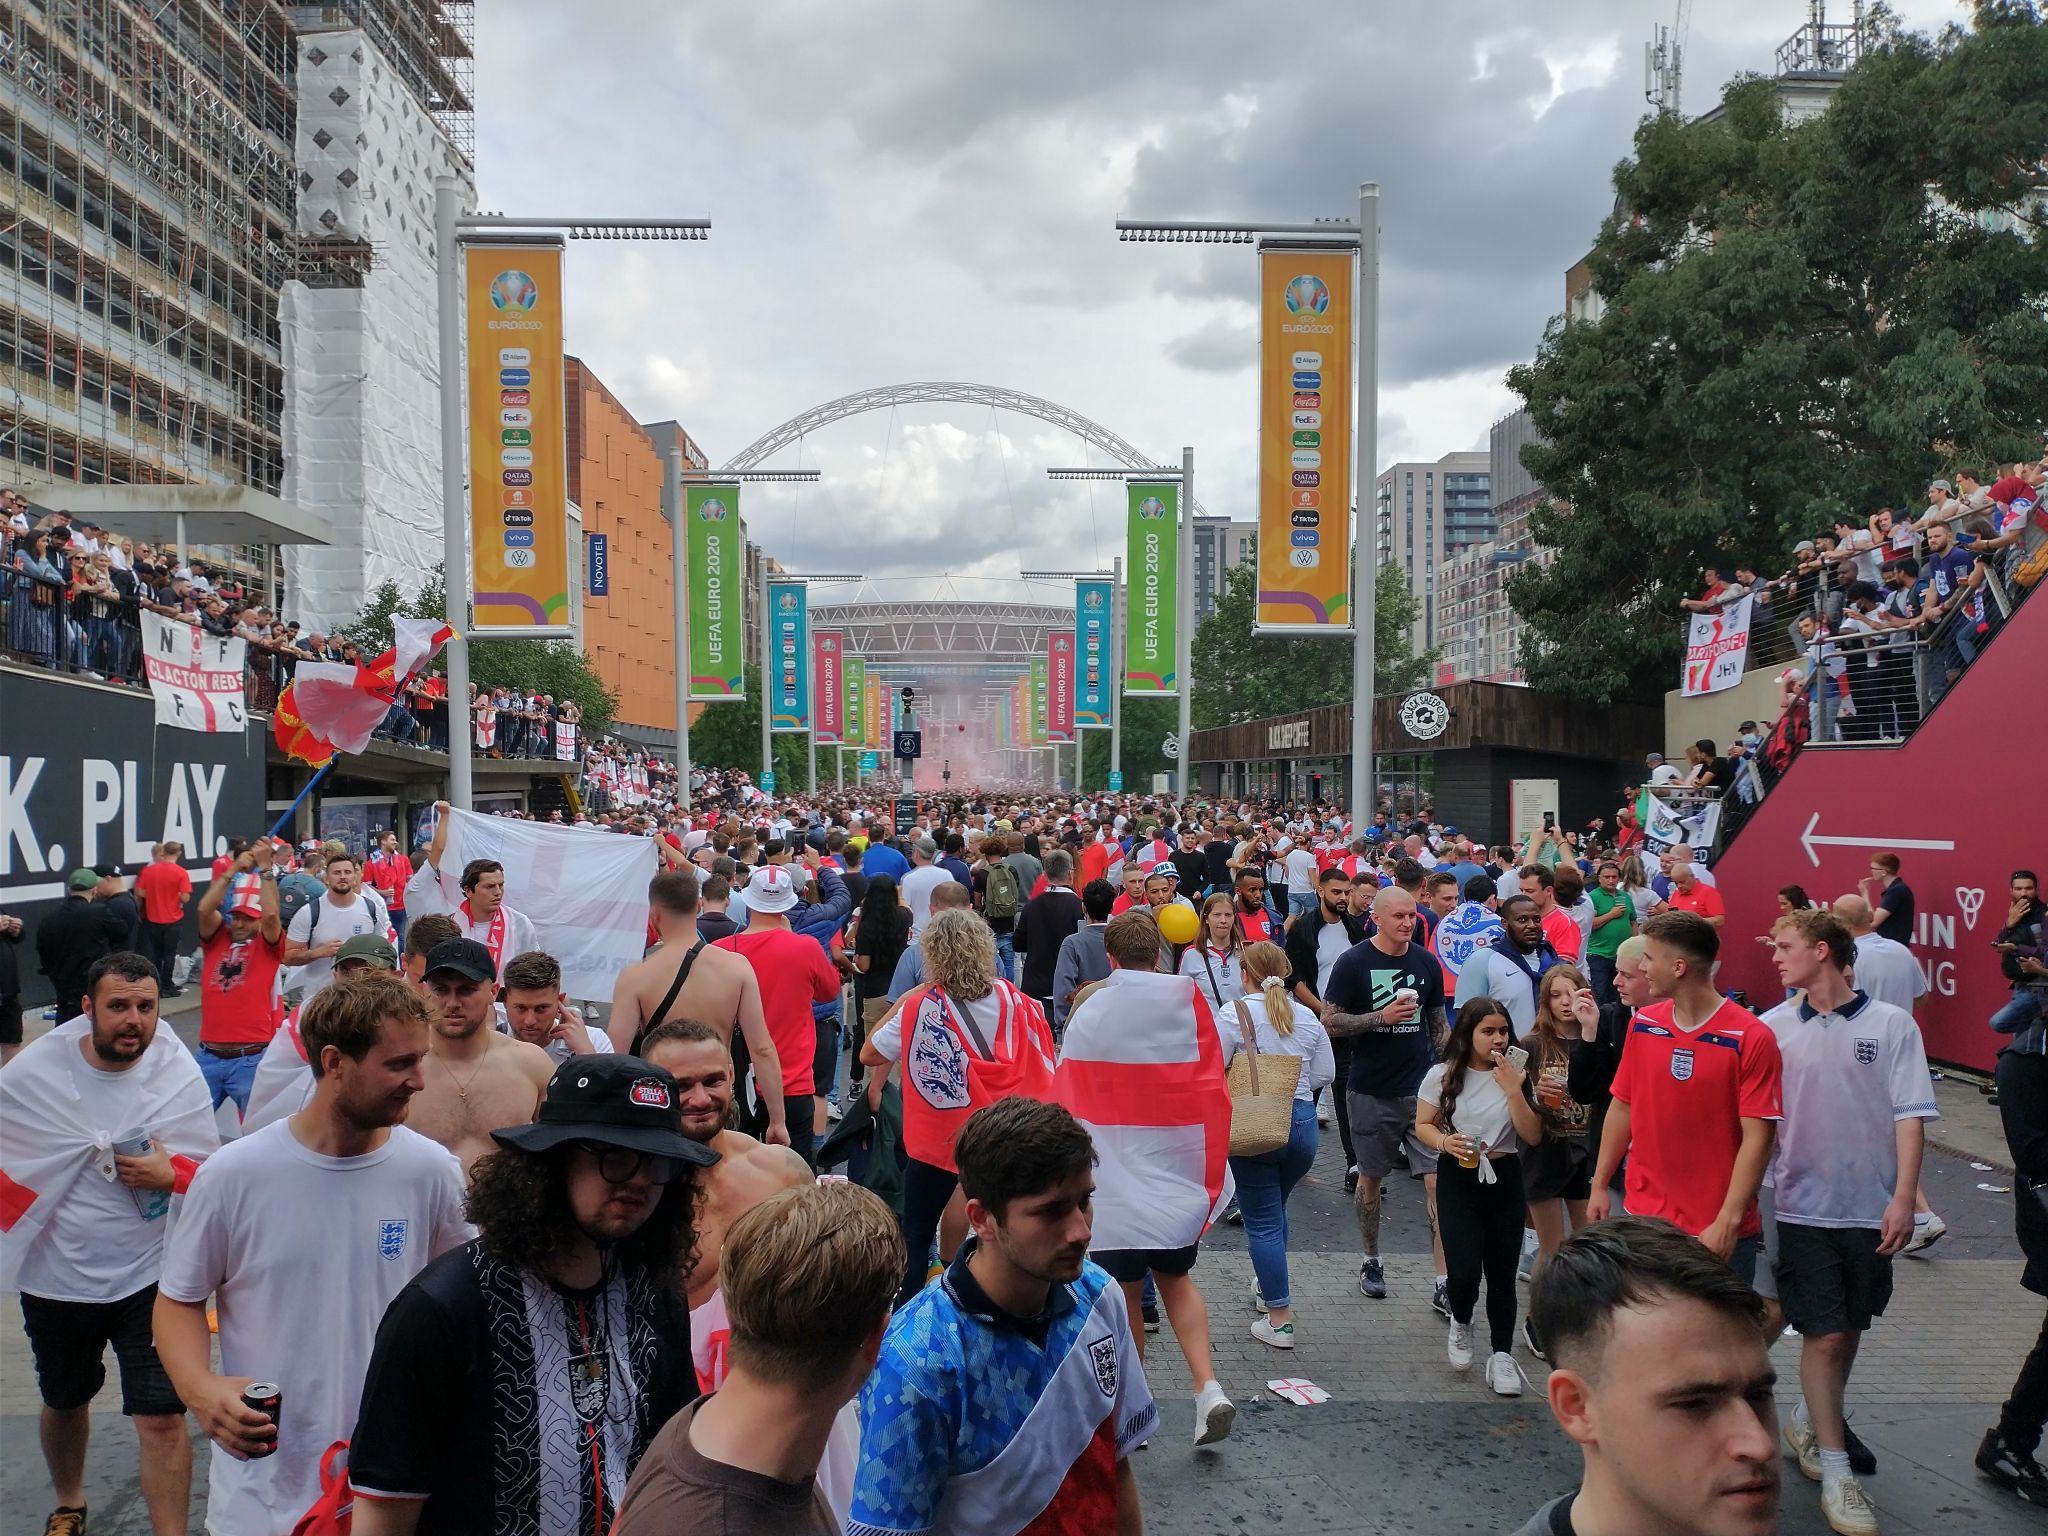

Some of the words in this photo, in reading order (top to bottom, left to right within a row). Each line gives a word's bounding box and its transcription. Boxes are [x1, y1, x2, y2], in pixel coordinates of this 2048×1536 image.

[504, 413, 527, 421] FedEx
[1295, 416, 1318, 424] FedEx
[594, 538, 603, 588] NOVOTEL
[707, 535, 720, 576] 2020
[1146, 533, 1159, 573] 2020
[708, 578, 721, 621] EURO
[1146, 574, 1159, 618] EURO
[160, 627, 173, 653] N
[219, 640, 228, 663] F
[709, 623, 722, 664] UEFA
[1146, 620, 1158, 660] UEFA
[148, 658, 208, 690] CLACTON
[1058, 658, 1066, 679] 2020
[825, 680, 833, 702] EURO
[1058, 680, 1066, 702] EURO
[172, 693, 184, 717] F
[228, 701, 242, 722] C
[826, 703, 834, 726] UEFA
[1057, 703, 1065, 725] UEFA
[1405, 698, 1420, 719] BLACK
[1420, 696, 1441, 707] SHEEP
[83, 758, 228, 868] PLAY.
[638, 1087, 663, 1097] STELLA
[640, 1093, 662, 1102] FELLA
